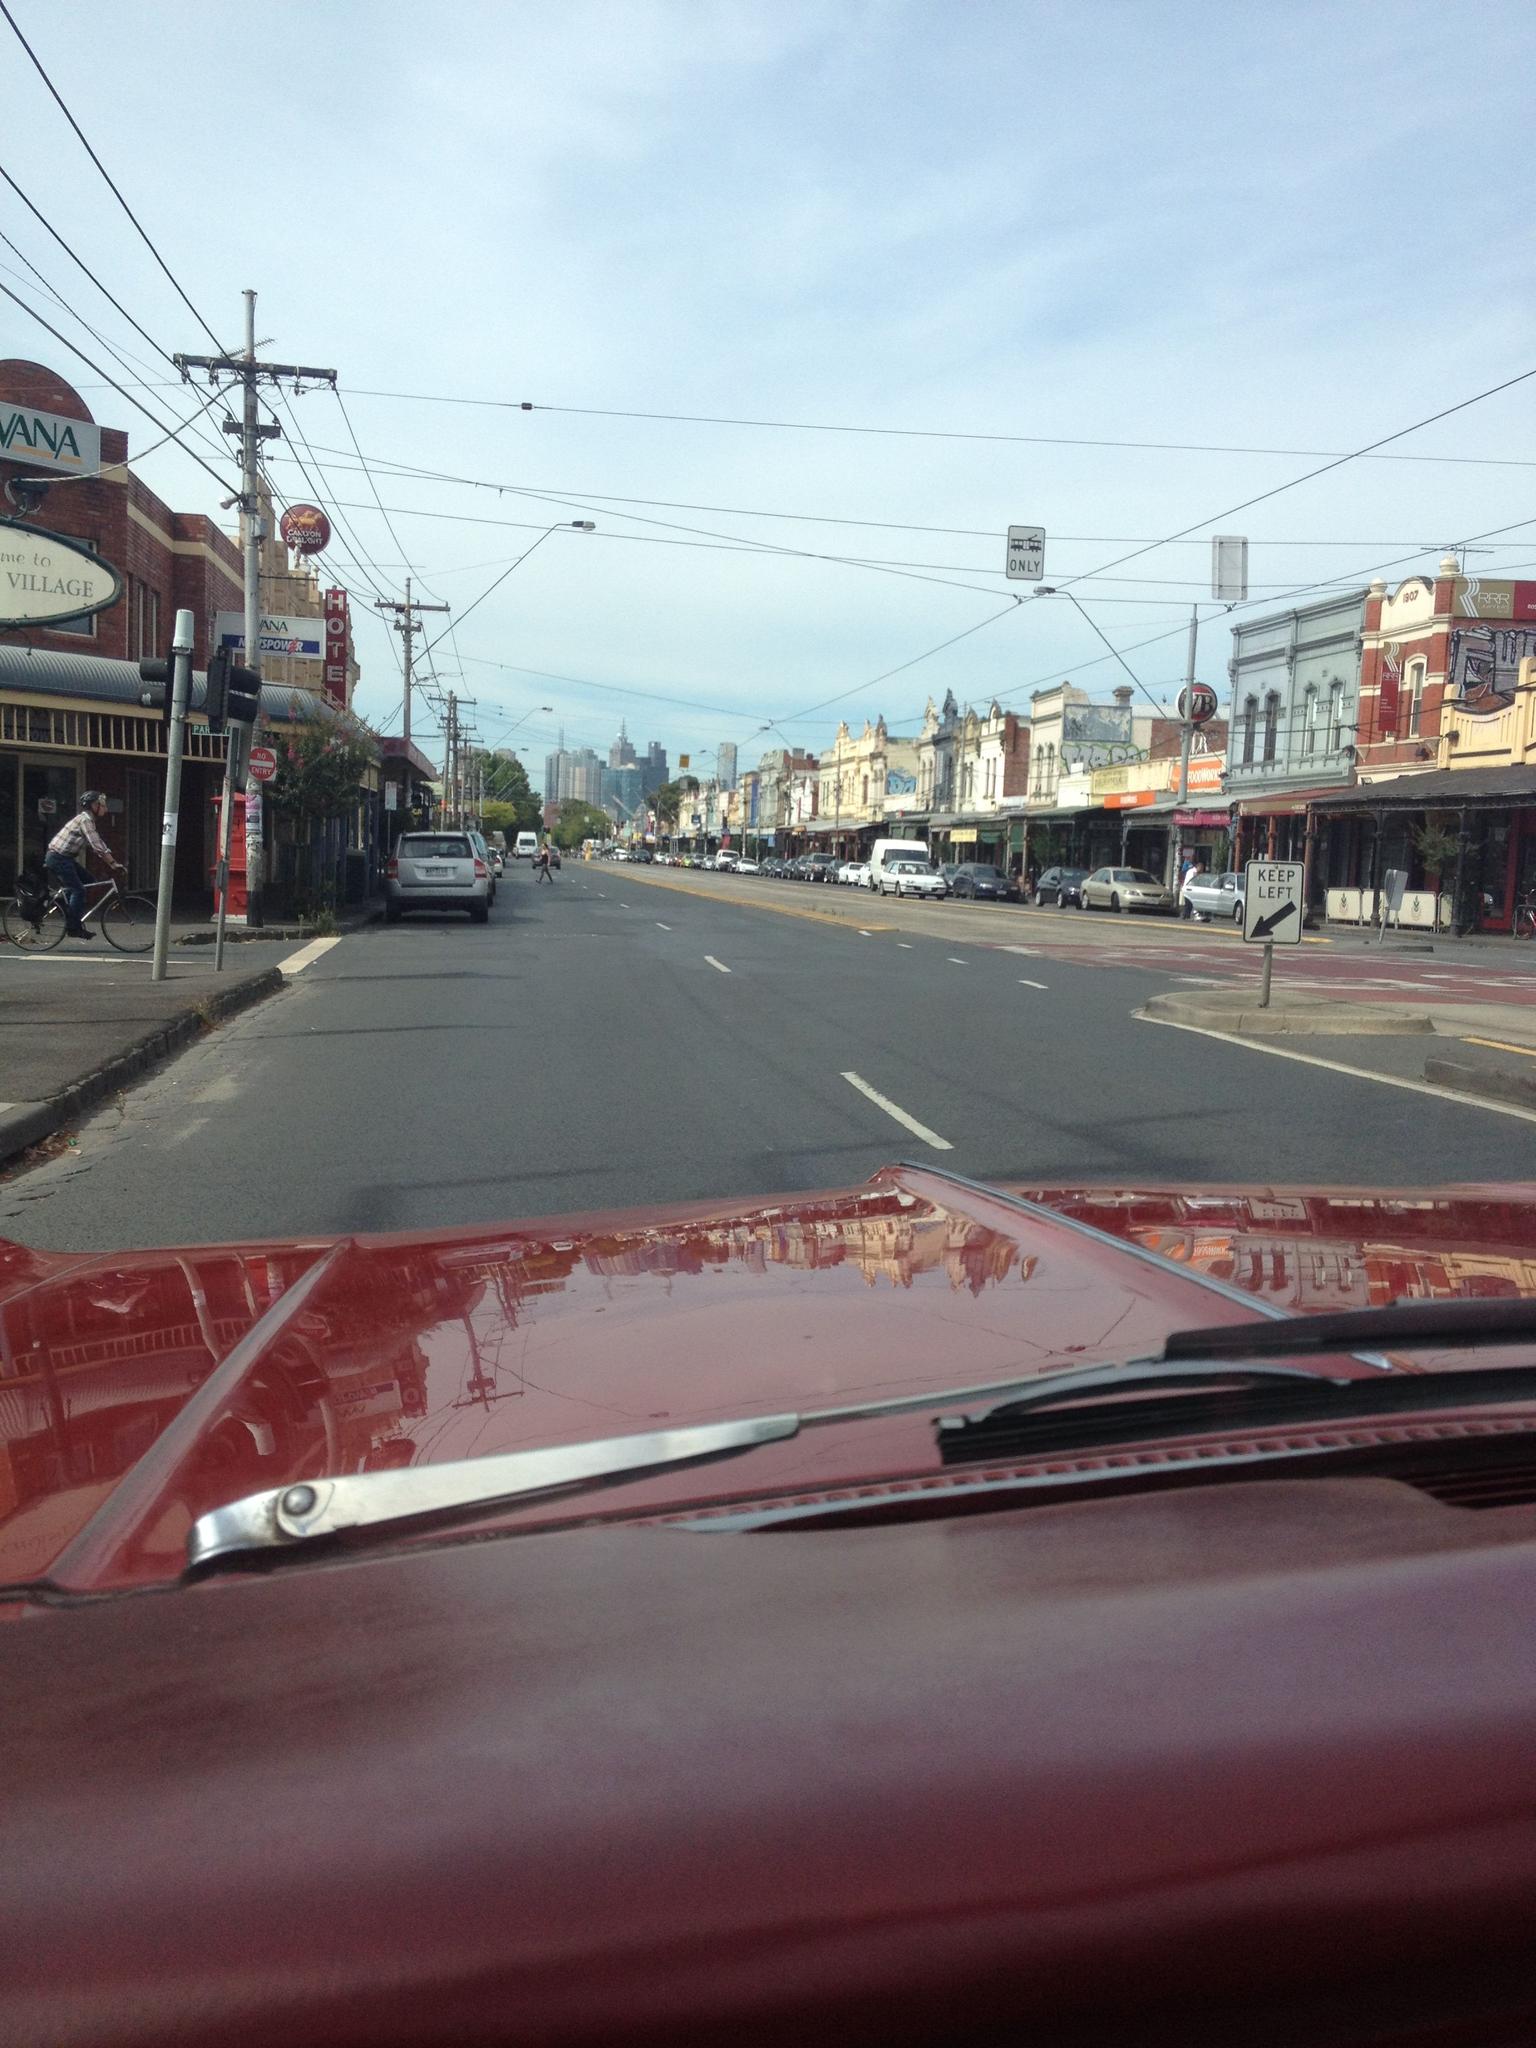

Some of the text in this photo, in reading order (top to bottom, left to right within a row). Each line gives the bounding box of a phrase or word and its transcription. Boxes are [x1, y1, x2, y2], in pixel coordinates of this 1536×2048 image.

[33, 553, 51, 567] to
[1010, 559, 1040, 572] ONLY
[6, 572, 94, 598] VILLAGE
[256, 752, 266, 760] NO
[251, 766, 272, 776] ENTRY
[1258, 869, 1296, 882] KEEP
[1258, 886, 1293, 899] LEFT
